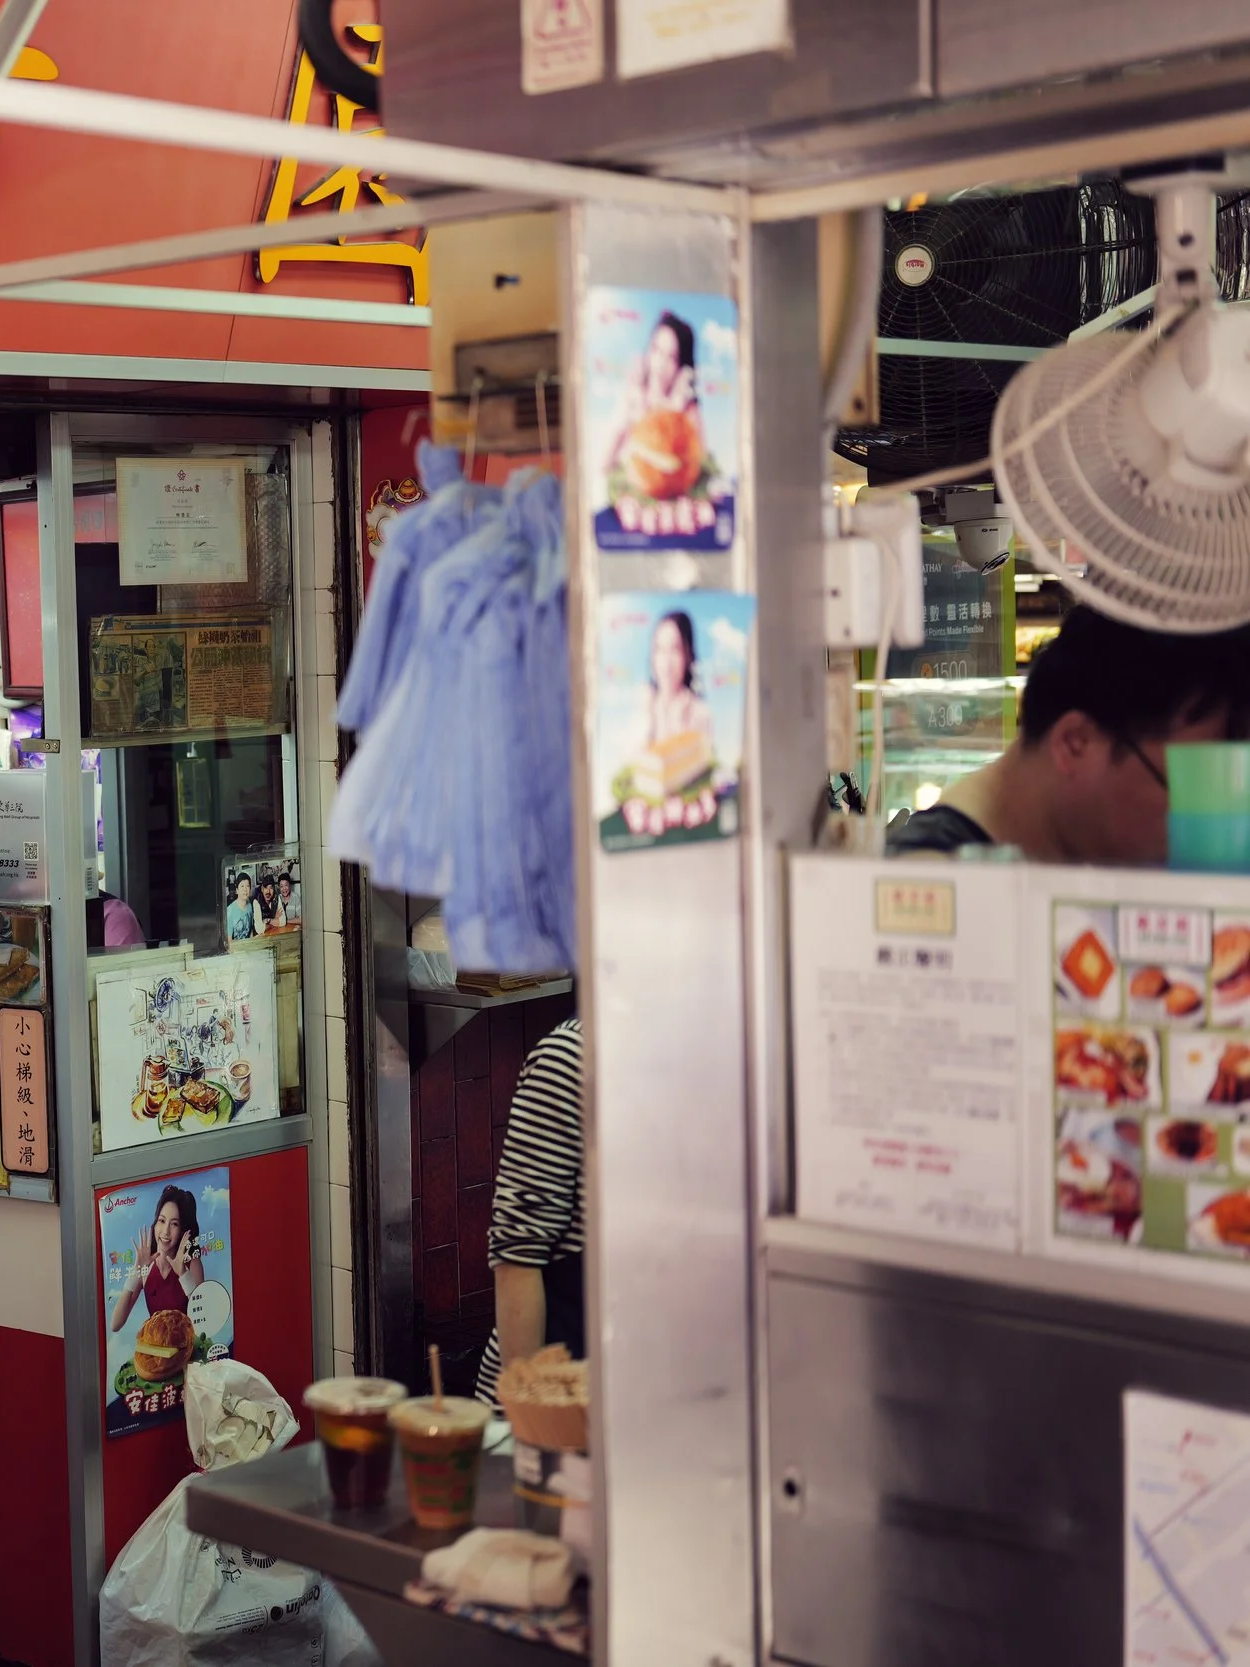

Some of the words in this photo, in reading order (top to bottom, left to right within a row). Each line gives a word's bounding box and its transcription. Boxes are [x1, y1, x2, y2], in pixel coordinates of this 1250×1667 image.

[921, 563, 943, 573] ATHAY
[15, 1016, 36, 1166] 小心梯級、地滑
[114, 1196, 138, 1207] Anchor
[109, 1265, 150, 1283] 鮮牛油
[125, 1385, 184, 1415] 安佳菠
